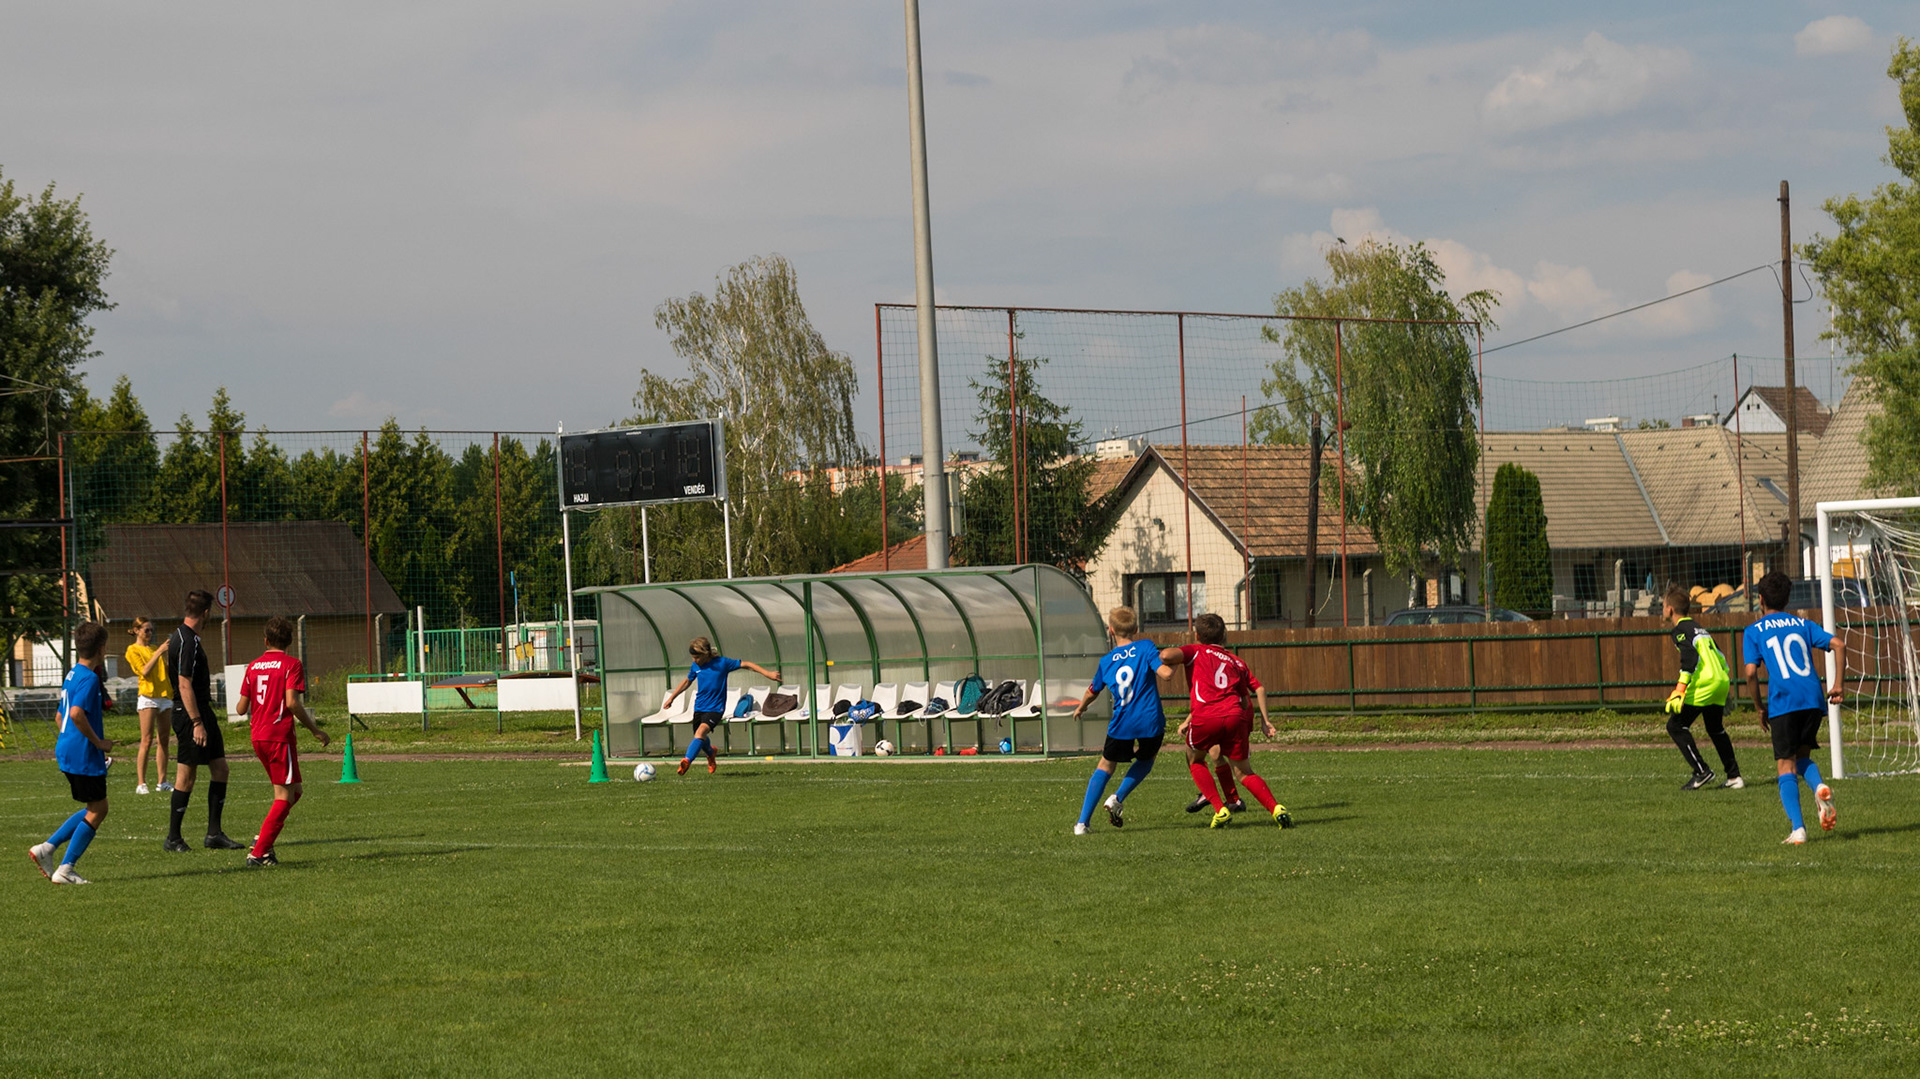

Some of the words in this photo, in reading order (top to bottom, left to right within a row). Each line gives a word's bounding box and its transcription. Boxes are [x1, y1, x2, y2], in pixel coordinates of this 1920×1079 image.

[573, 493, 589, 503] HAZAI
[683, 482, 706, 495] VENDÉG
[1754, 617, 1805, 633] TANMAY
[1766, 632, 1811, 680] 10
[1115, 665, 1135, 707] 8
[1214, 661, 1228, 689] 6
[256, 674, 269, 705] 5
